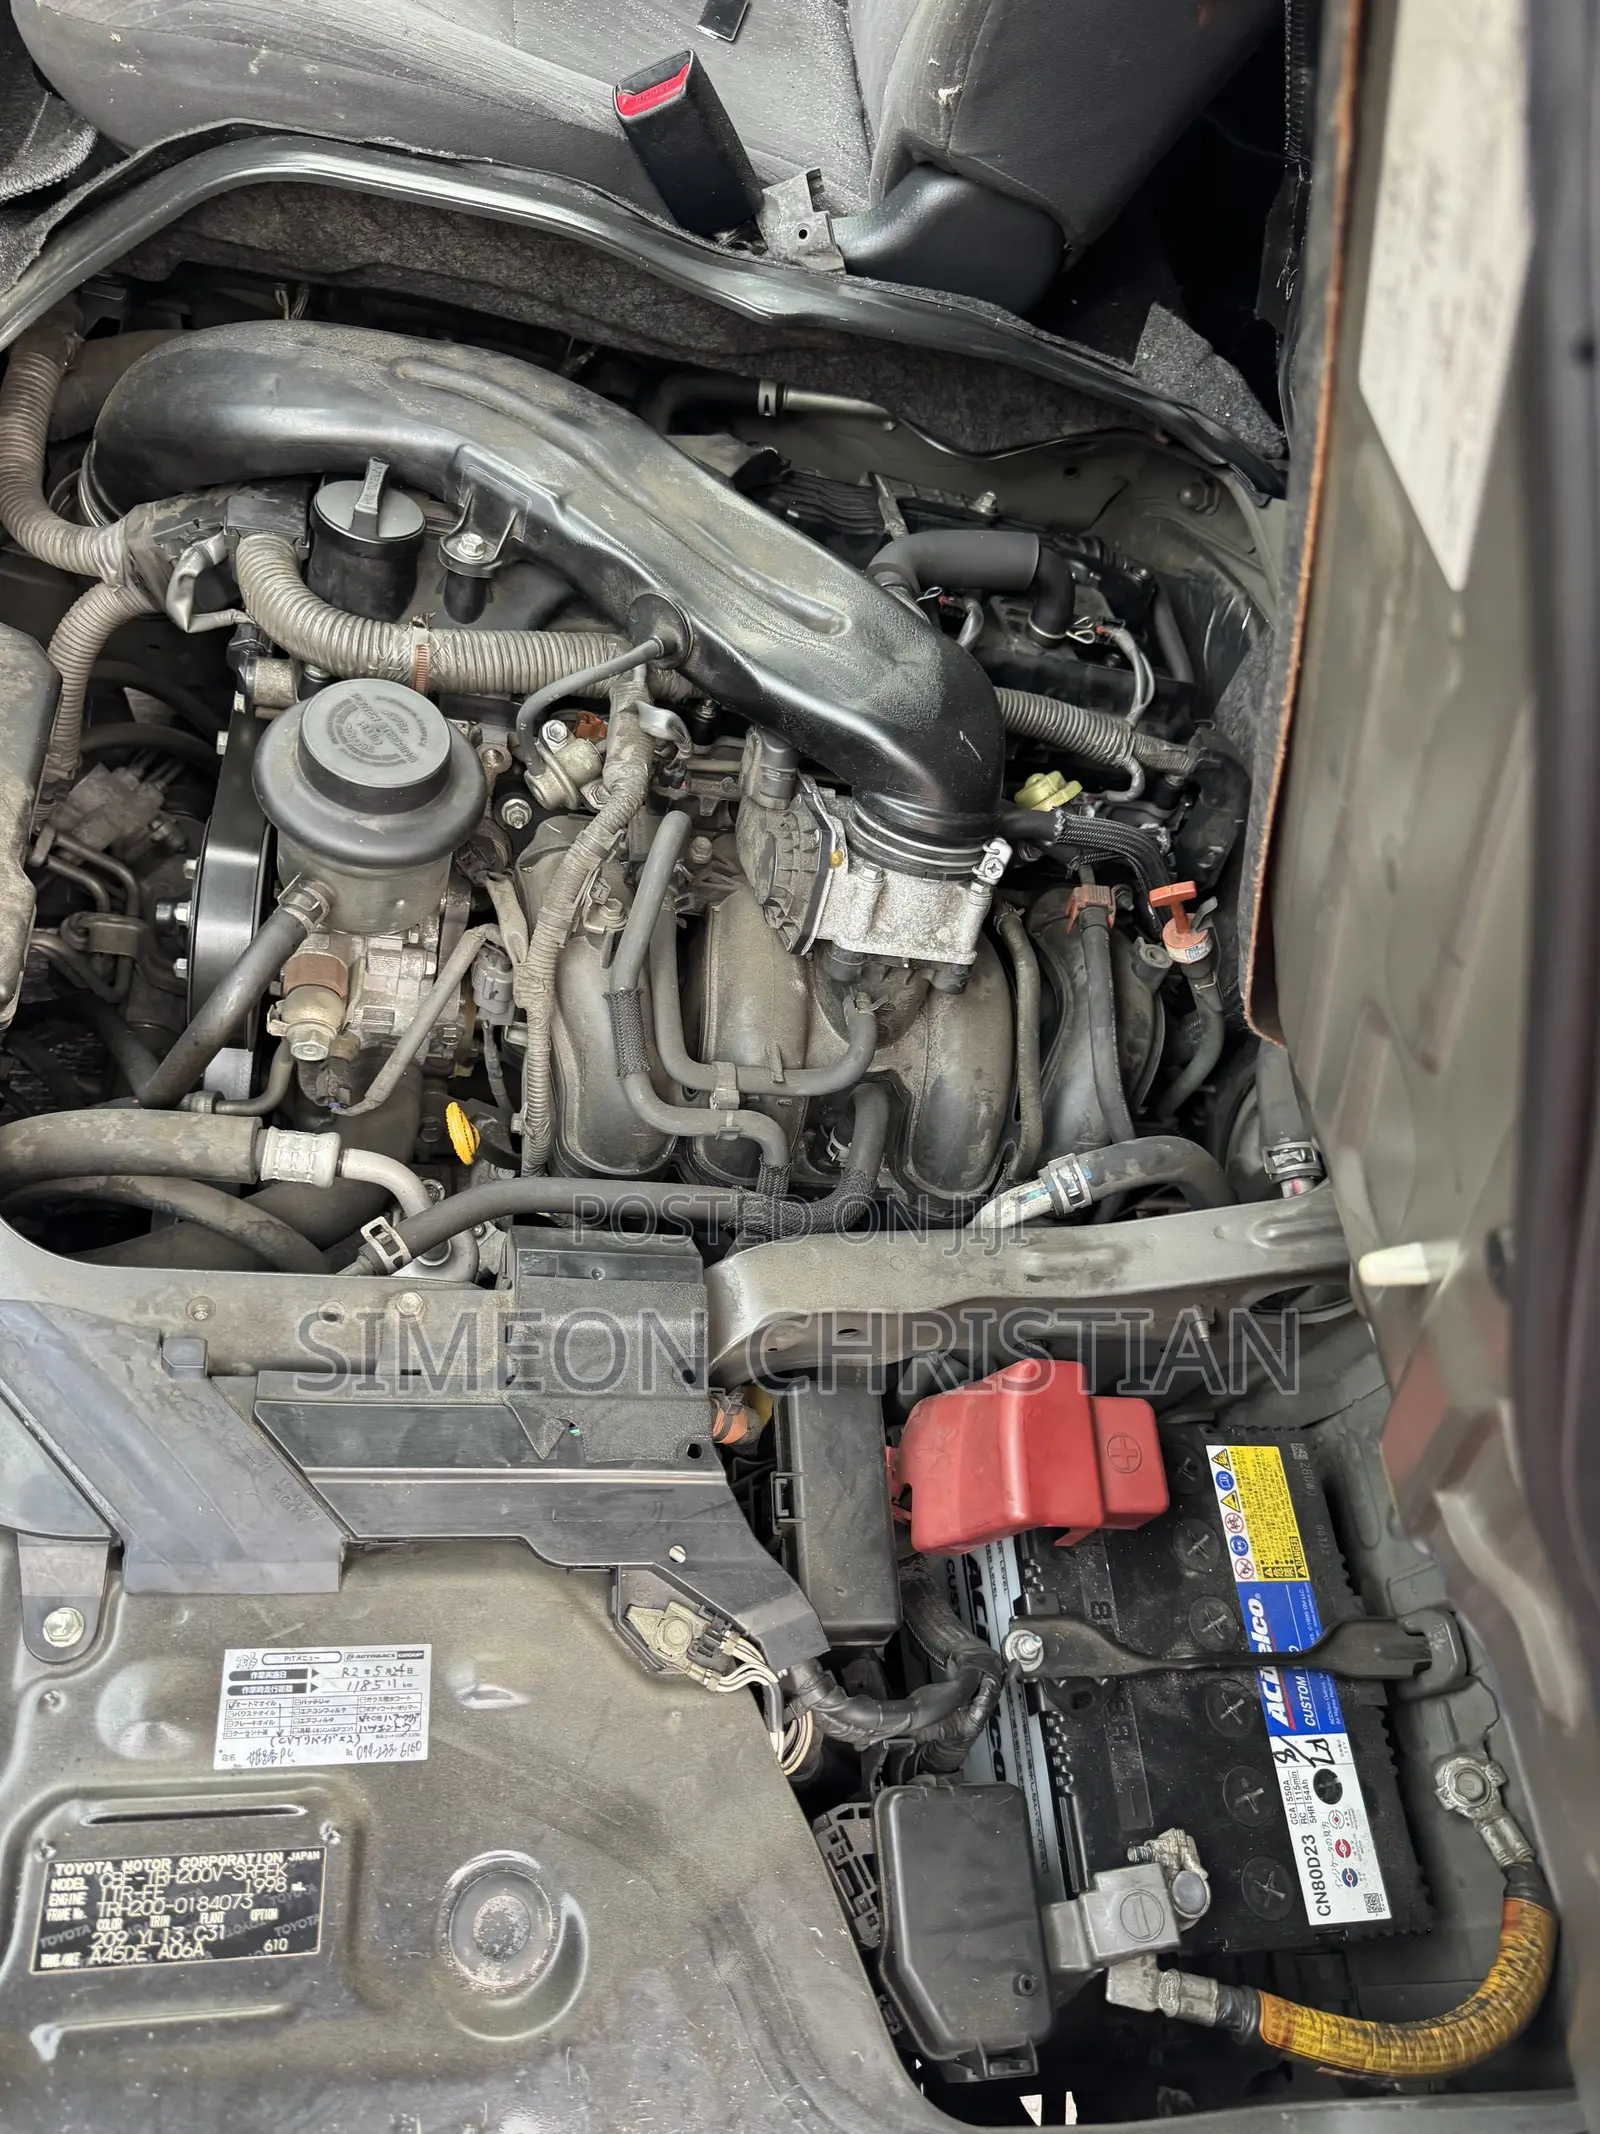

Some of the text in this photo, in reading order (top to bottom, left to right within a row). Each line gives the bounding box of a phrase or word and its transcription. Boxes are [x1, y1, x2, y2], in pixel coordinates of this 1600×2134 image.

[1290, 1537, 1304, 1567] DANGER
[1295, 1676, 1316, 1726] CUSTOM
[1283, 1779, 1298, 1825] CCA 550A
[1291, 1771, 1308, 1825] RC 115min
[1302, 1779, 1318, 1824] 5HR 54Ah
[55, 1851, 320, 1876] TOYOTA MOTOR CORPORATION JAPAN
[1322, 1821, 1343, 1889] インジケータの見方
[50, 1877, 90, 1892] MODEL
[1301, 1834, 1332, 1917] CN80D23
[48, 1892, 88, 1907] ENGINE
[245, 1877, 287, 1894] 1998
[46, 1907, 72, 1922] FRAME
[96, 1893, 254, 1918] TRH200-0184073
[96, 1918, 123, 1931] COLOR
[149, 1914, 171, 1928] TRIM
[199, 1911, 225, 1924] PLANT
[249, 1908, 279, 1921] OPTION
[91, 1931, 129, 1949] 209
[193, 1924, 225, 1941] C31
[157, 1941, 205, 1959] A06A
[263, 1938, 289, 1953] 610
